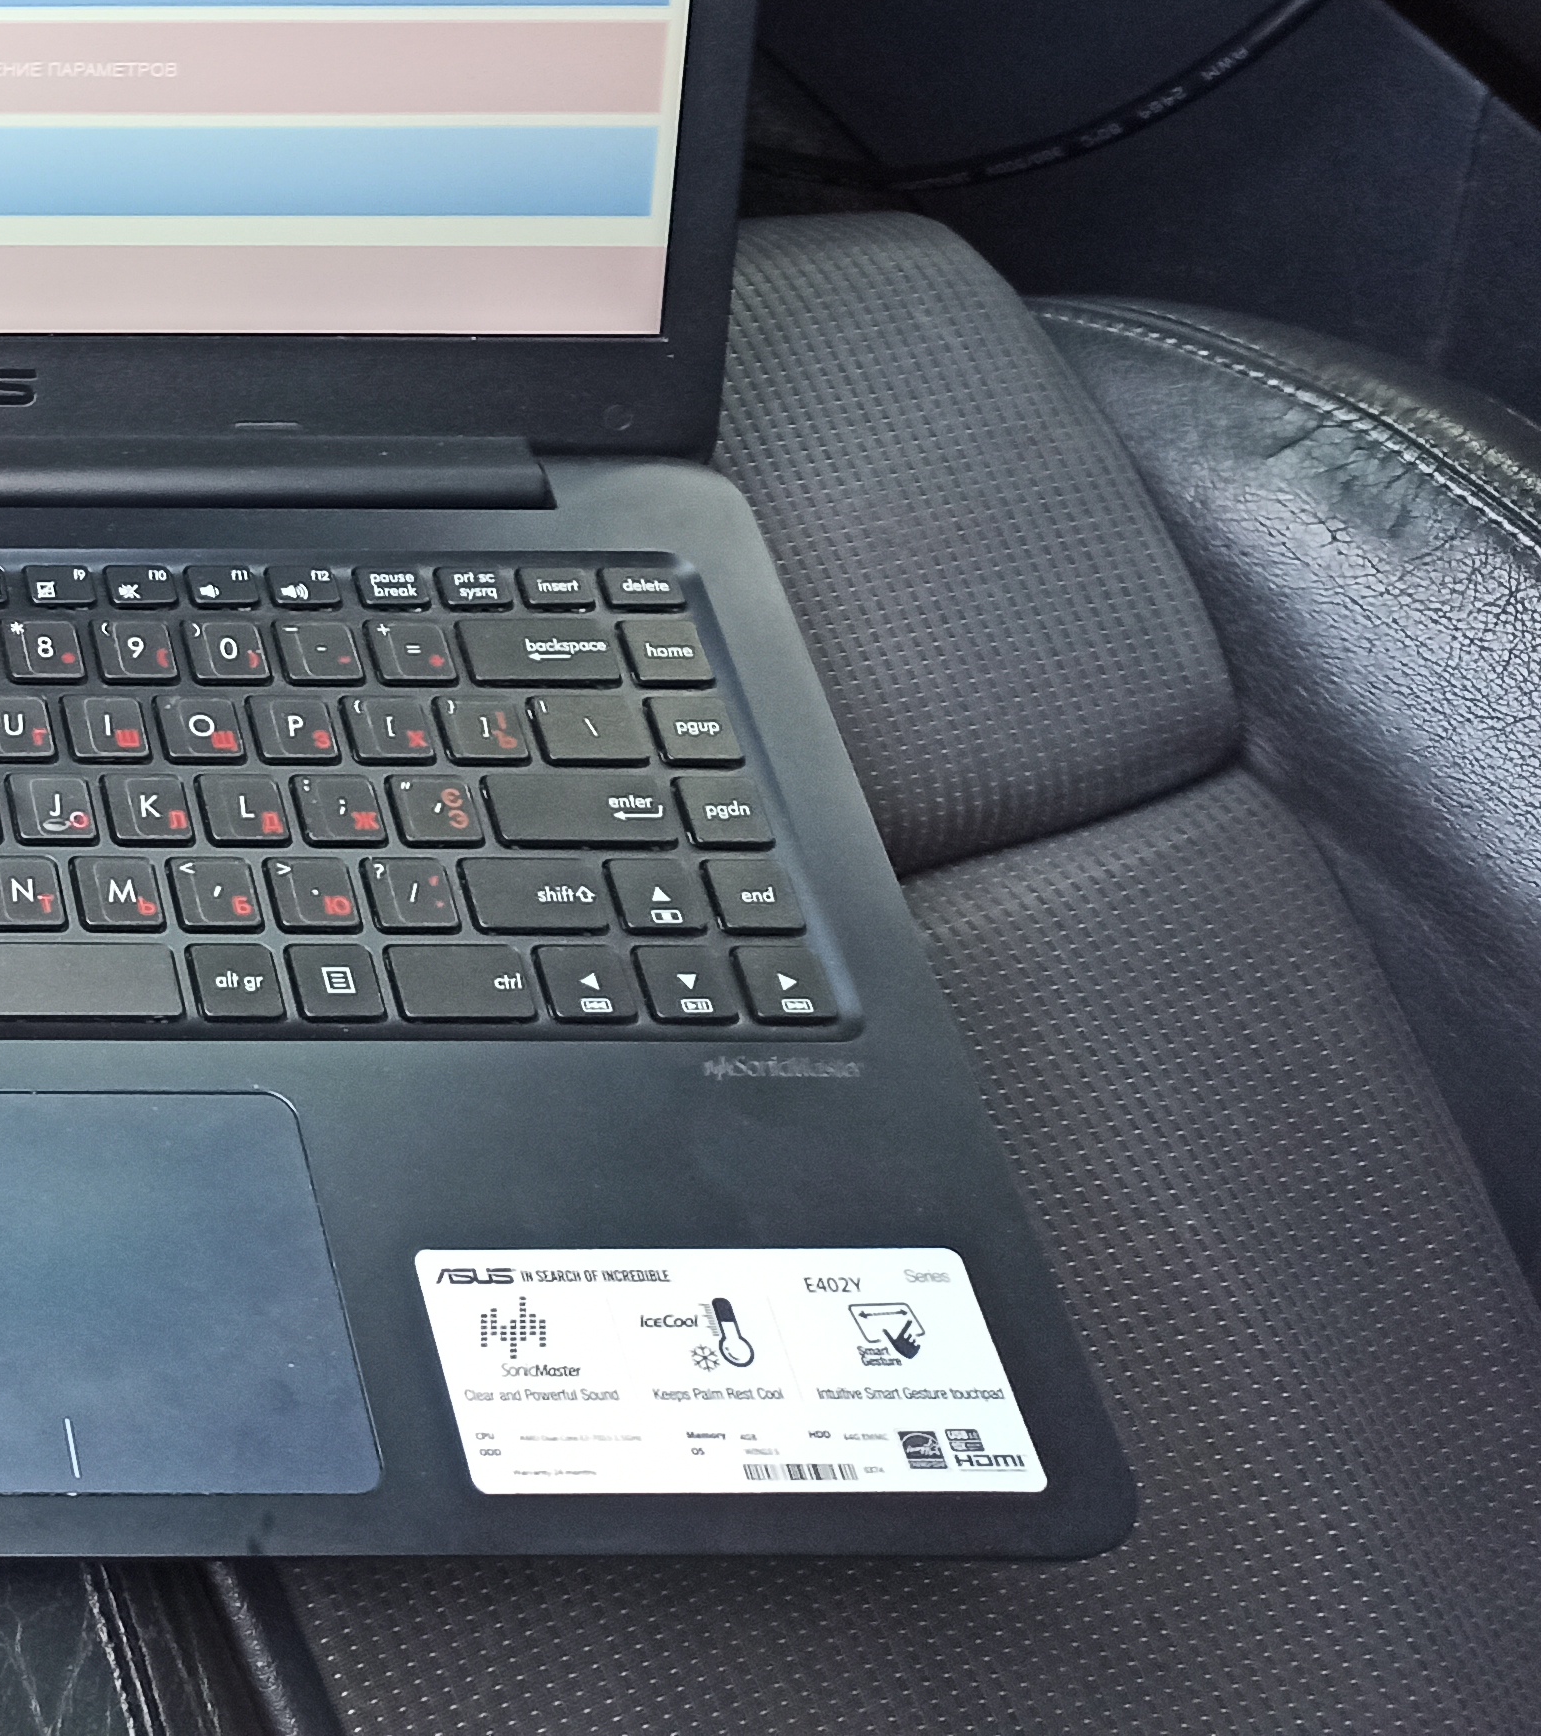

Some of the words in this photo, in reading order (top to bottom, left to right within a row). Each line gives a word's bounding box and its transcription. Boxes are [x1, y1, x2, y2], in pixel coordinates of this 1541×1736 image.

[48, 62, 178, 78] ПАРАМЕТРОВ
[230, 569, 249, 581] f11
[310, 569, 330, 582] f12
[369, 572, 415, 587] pause
[453, 571, 475, 586] prt
[477, 573, 496, 583] sc
[373, 584, 419, 598] break
[536, 579, 579, 592] insert
[622, 578, 670, 592] delete
[459, 587, 498, 601] sysrq
[37, 636, 54, 658] 8
[127, 636, 145, 659] 9
[219, 637, 238, 660] 0
[524, 638, 607, 654] backspace
[645, 642, 694, 658] home
[3, 713, 24, 736] U
[188, 714, 215, 737] O
[287, 715, 304, 737] P
[675, 721, 720, 736] pgup
[49, 793, 61, 817] J
[139, 794, 161, 818] K
[239, 795, 255, 818] L
[608, 794, 653, 809] enter
[705, 800, 751, 820] pgdn
[11, 878, 34, 902] N
[108, 879, 137, 903] M
[537, 885, 575, 903] shift
[741, 886, 775, 903] end
[215, 970, 239, 988] alt
[243, 976, 264, 992] gr
[493, 972, 523, 990] ctrl
[436, 1268, 515, 1284] ASUS
[520, 1270, 534, 1283] IN
[537, 1270, 582, 1283] SEARCH
[584, 1270, 599, 1283] OF
[602, 1270, 672, 1283] INCREDIBLE
[903, 1269, 951, 1283] Series
[803, 1277, 861, 1293] E402Y
[857, 1346, 890, 1356] Smart
[861, 1355, 902, 1366] Gesture
[502, 1363, 581, 1377] SonicMaster
[464, 1389, 494, 1401] Clear
[499, 1389, 521, 1401] and
[525, 1389, 578, 1401] Powerful
[581, 1389, 619, 1401] Sound
[652, 1388, 691, 1402] Keeps
[692, 1387, 724, 1400] Palm
[726, 1388, 755, 1400] Rest
[757, 1387, 784, 1400] Cool
[817, 1387, 863, 1400] Intuitive
[864, 1387, 902, 1400] Smart
[902, 1387, 948, 1400] Gesture
[949, 1387, 1005, 1402] touchpad
[475, 1432, 495, 1441] CPU
[691, 1448, 706, 1456] OS
[954, 1453, 1026, 1468] HDMI
